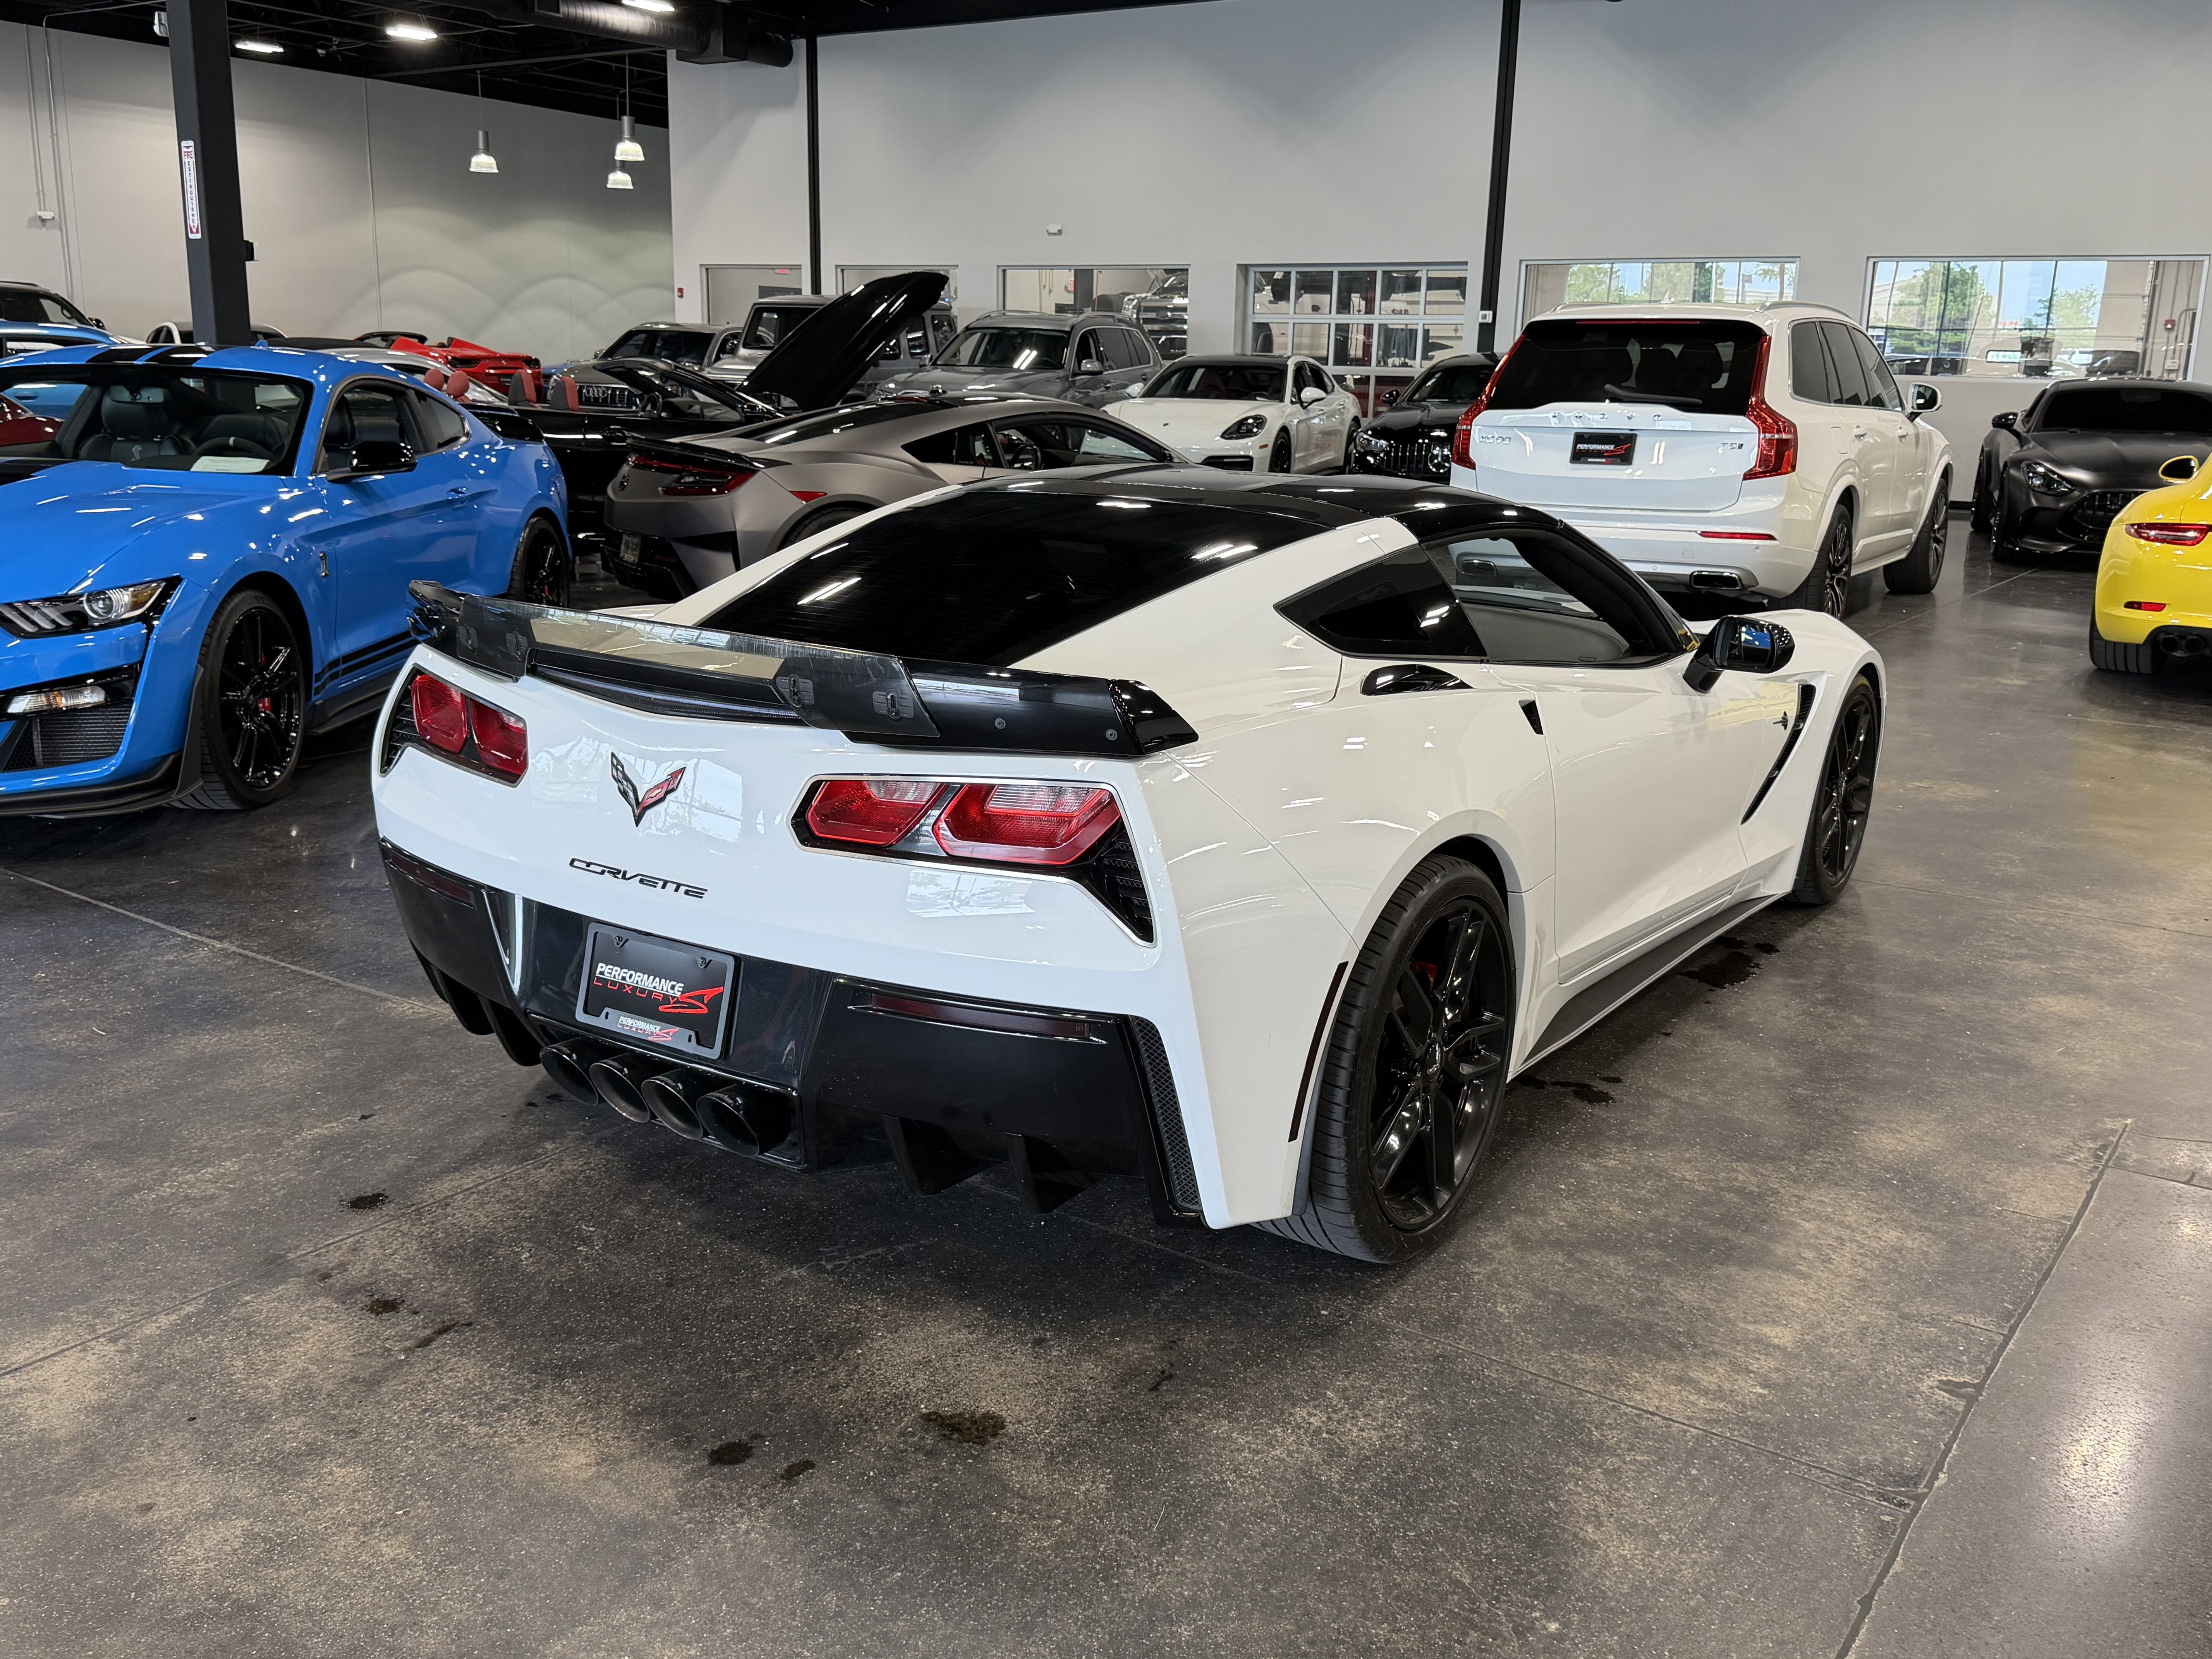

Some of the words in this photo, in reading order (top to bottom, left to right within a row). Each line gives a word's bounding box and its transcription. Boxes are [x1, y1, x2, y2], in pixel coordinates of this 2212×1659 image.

[187, 161, 196, 228] EXTINGUISHER
[569, 857, 708, 899] CORVETTE
[593, 977, 678, 1005] LUXURY
[596, 962, 684, 995] PERFORMANCE
[618, 1016, 661, 1031] PERFORMANCE
